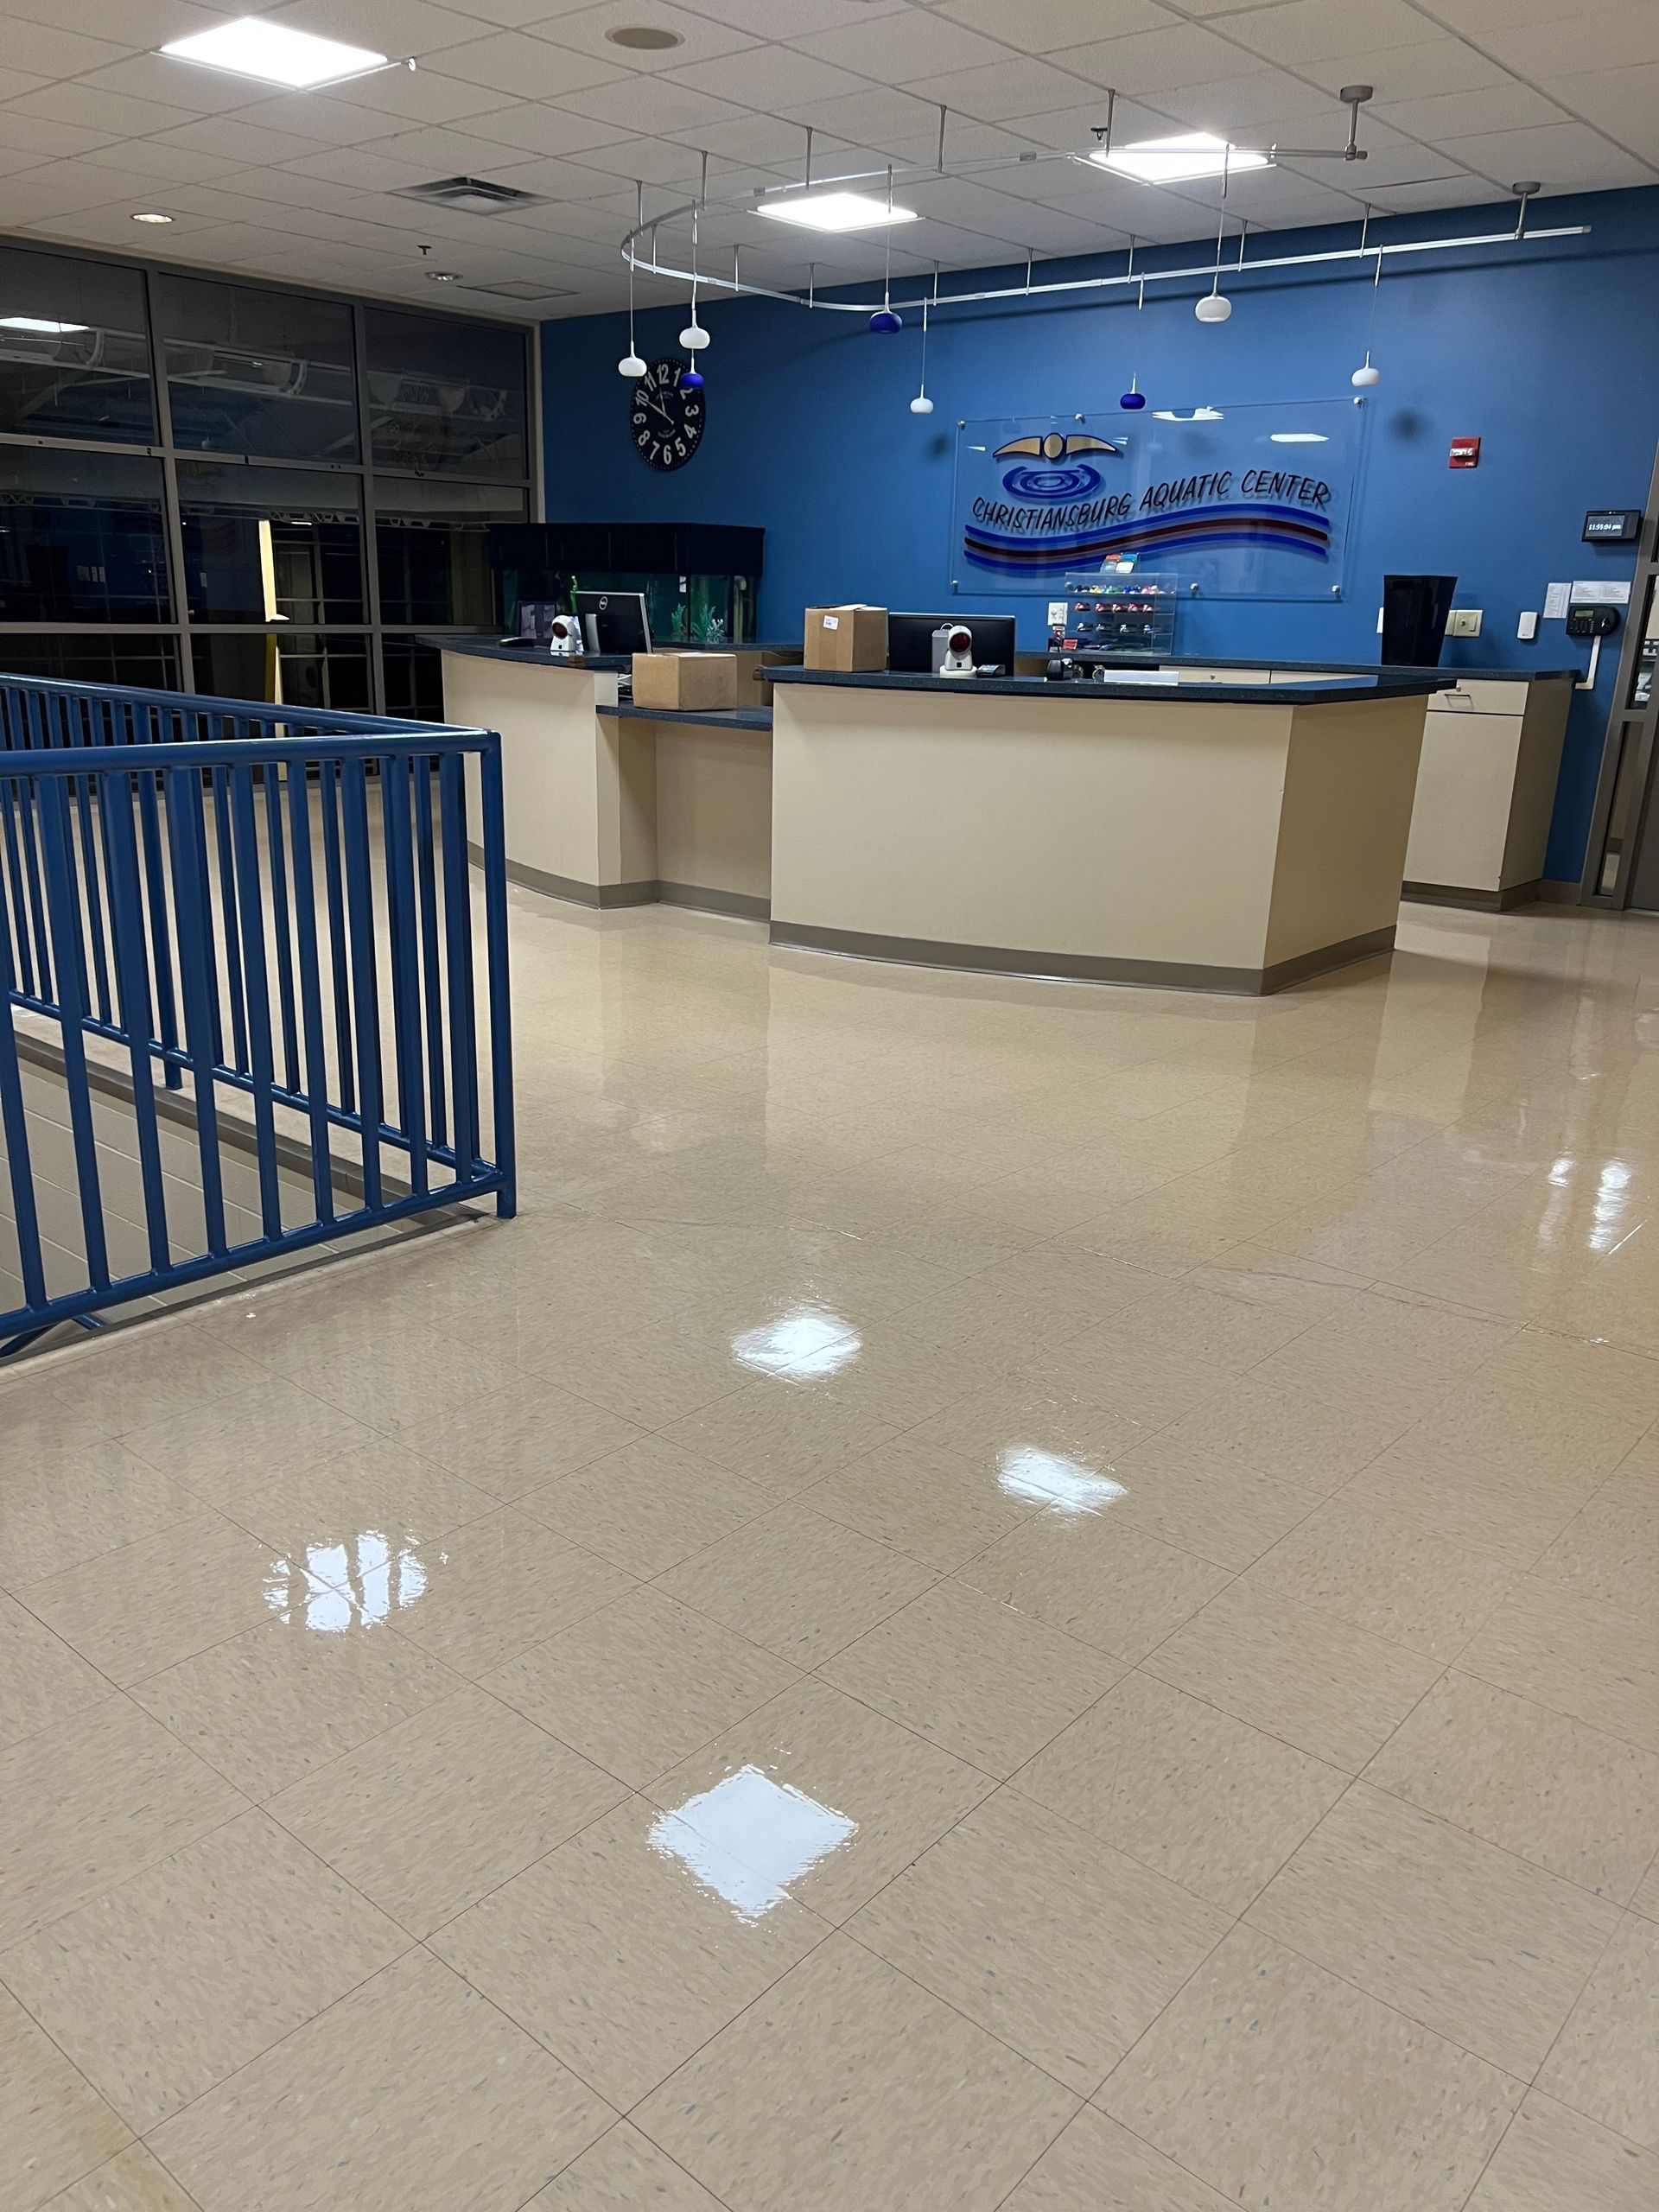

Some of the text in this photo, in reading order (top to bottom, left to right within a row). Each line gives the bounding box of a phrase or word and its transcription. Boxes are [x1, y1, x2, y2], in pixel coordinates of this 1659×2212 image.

[645, 372, 657, 391] 11
[657, 364, 669, 385] 12
[674, 367, 681, 387] 1
[635, 389, 649, 407] 10
[632, 412, 646, 424] 9
[685, 404, 699, 416] 3
[638, 430, 650, 446] 8
[683, 423, 697, 439] 4
[650, 441, 660, 460] 7
[663, 444, 672, 464] 6
[674, 437, 686, 456] 5
[972, 469, 1329, 531] CHRISTIANSBURG AQUATIC CENTER
